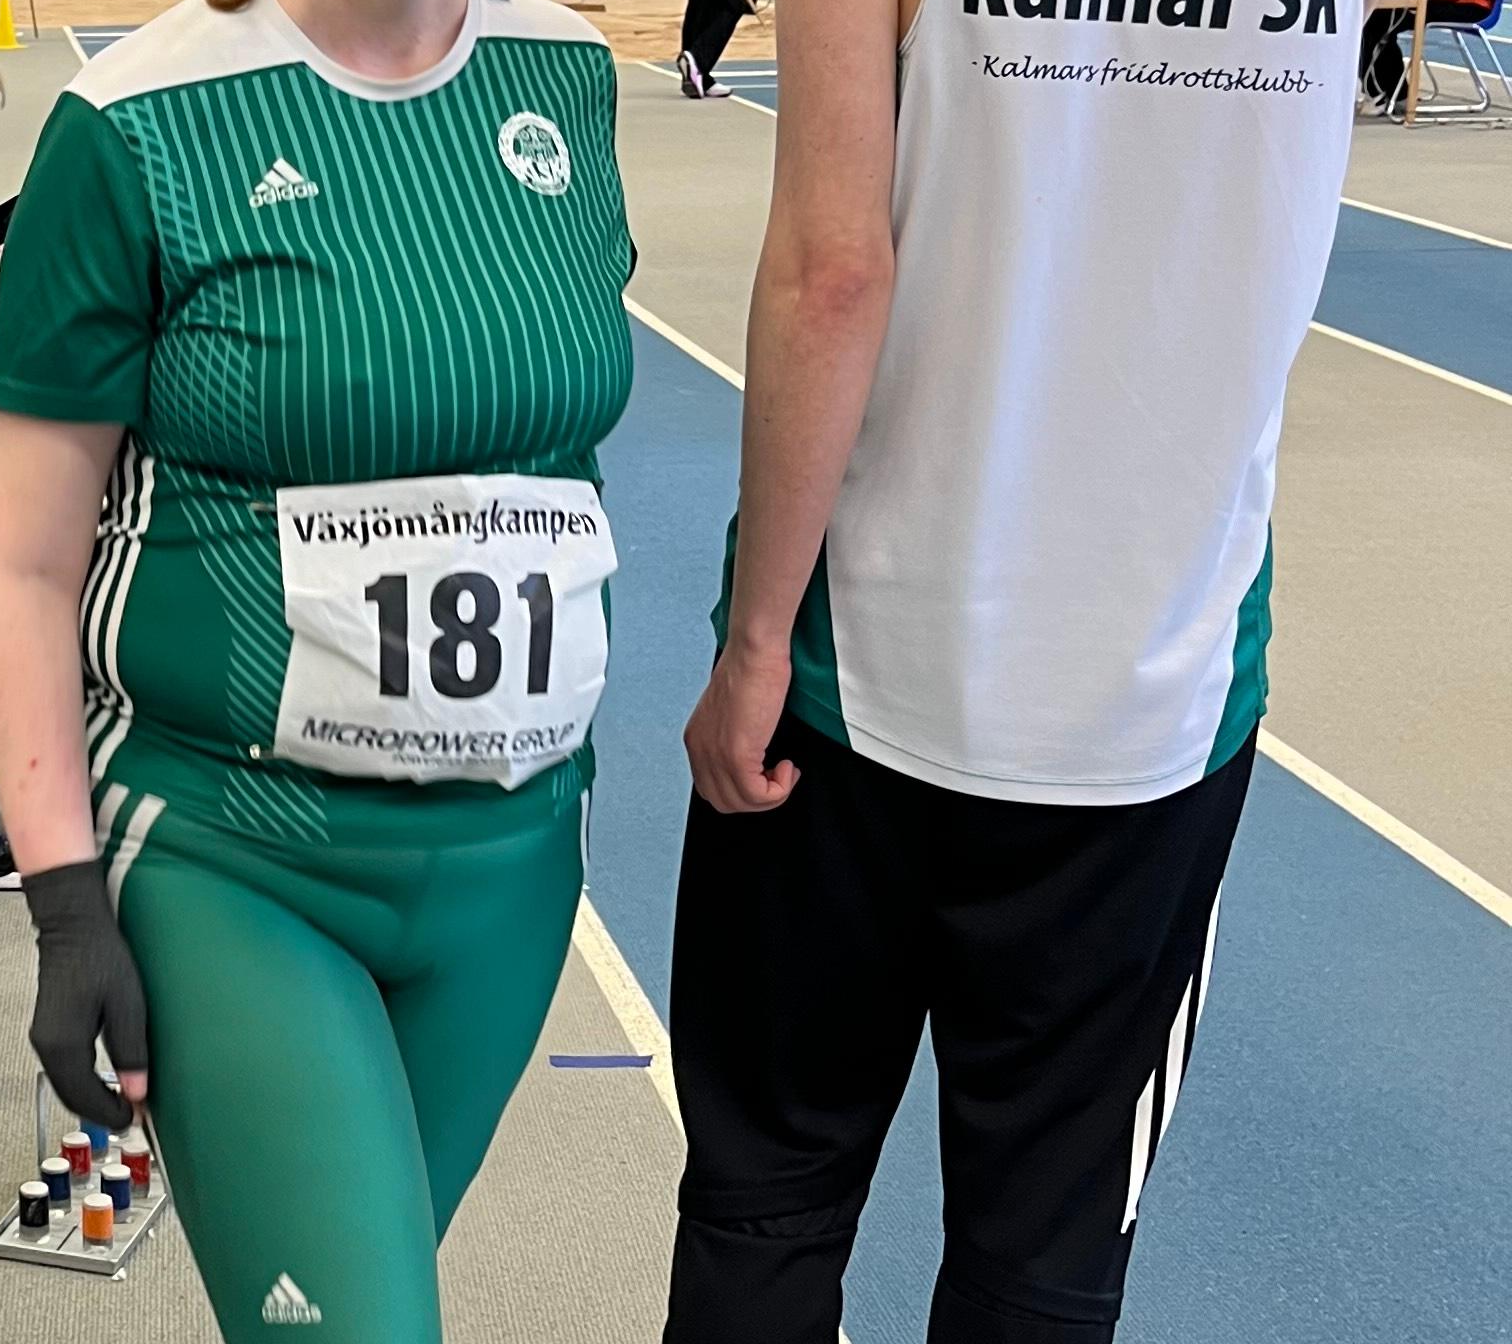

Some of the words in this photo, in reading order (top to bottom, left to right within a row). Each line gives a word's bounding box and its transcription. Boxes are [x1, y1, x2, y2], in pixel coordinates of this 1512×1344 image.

[982, 55, 1095, 83] Kalmars
[1098, 58, 1316, 94] friidrottsklubb
[248, 181, 320, 210] adidas
[292, 499, 599, 549] Växjömångkampen
[363, 572, 555, 699] 181
[300, 716, 508, 757] MICROPOWER
[511, 721, 576, 754] GROUP
